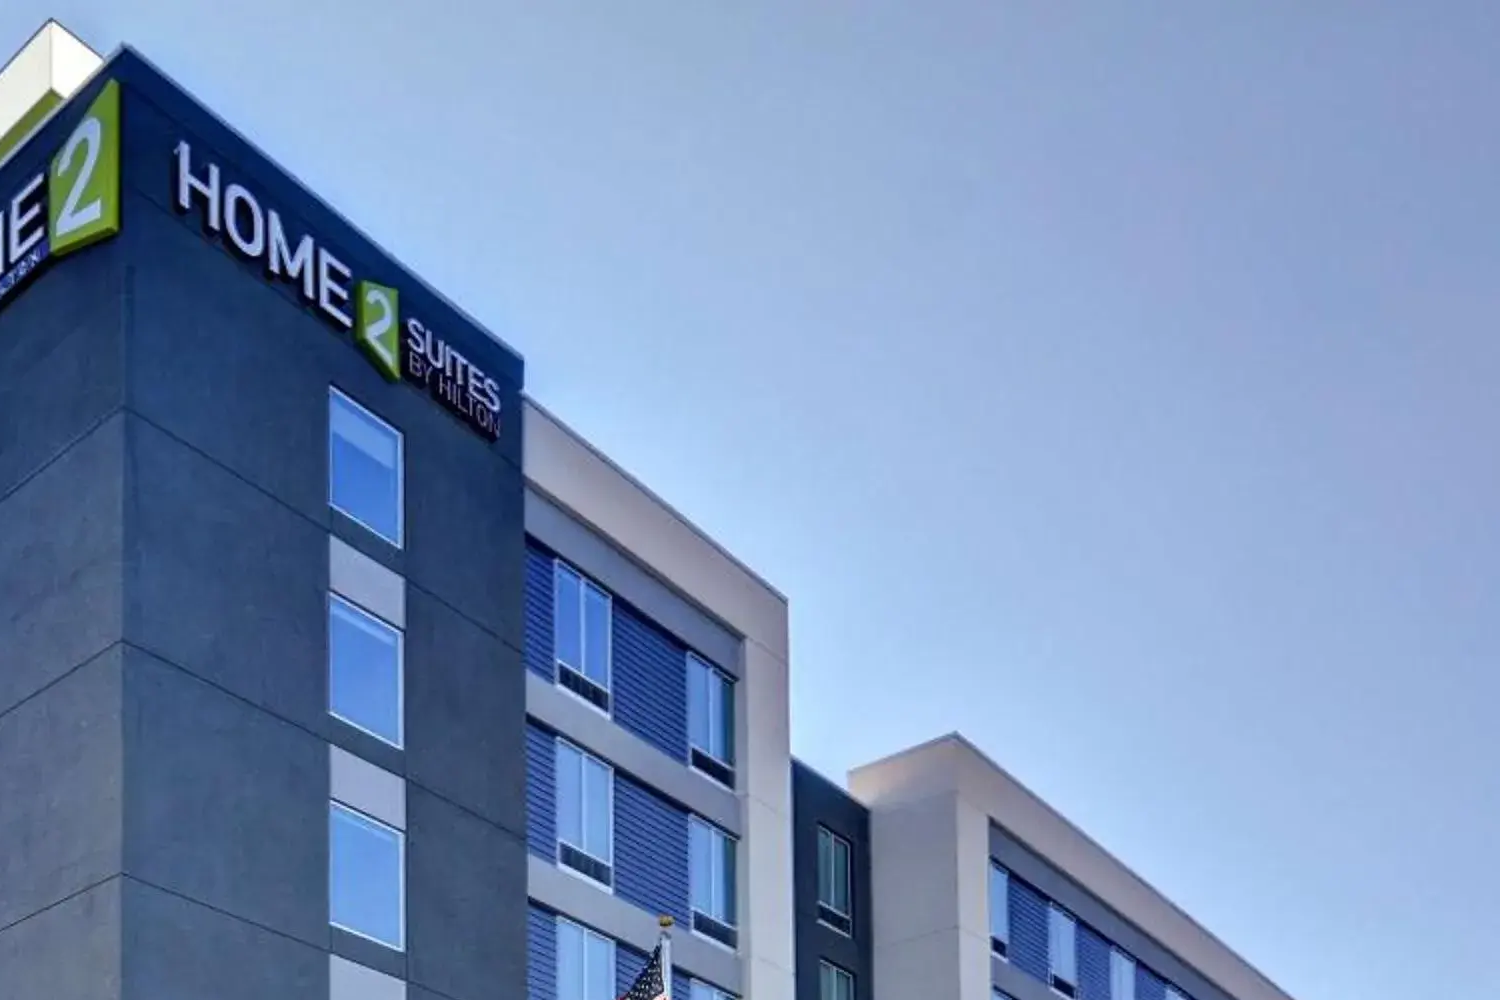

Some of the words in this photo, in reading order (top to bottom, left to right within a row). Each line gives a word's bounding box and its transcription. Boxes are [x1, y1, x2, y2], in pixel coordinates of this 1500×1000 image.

[56, 117, 102, 237] 2
[174, 140, 352, 328] HOME
[366, 289, 396, 369] 2
[407, 318, 501, 412] SUITES
[409, 351, 433, 384] BY
[438, 373, 501, 438] HILTON
